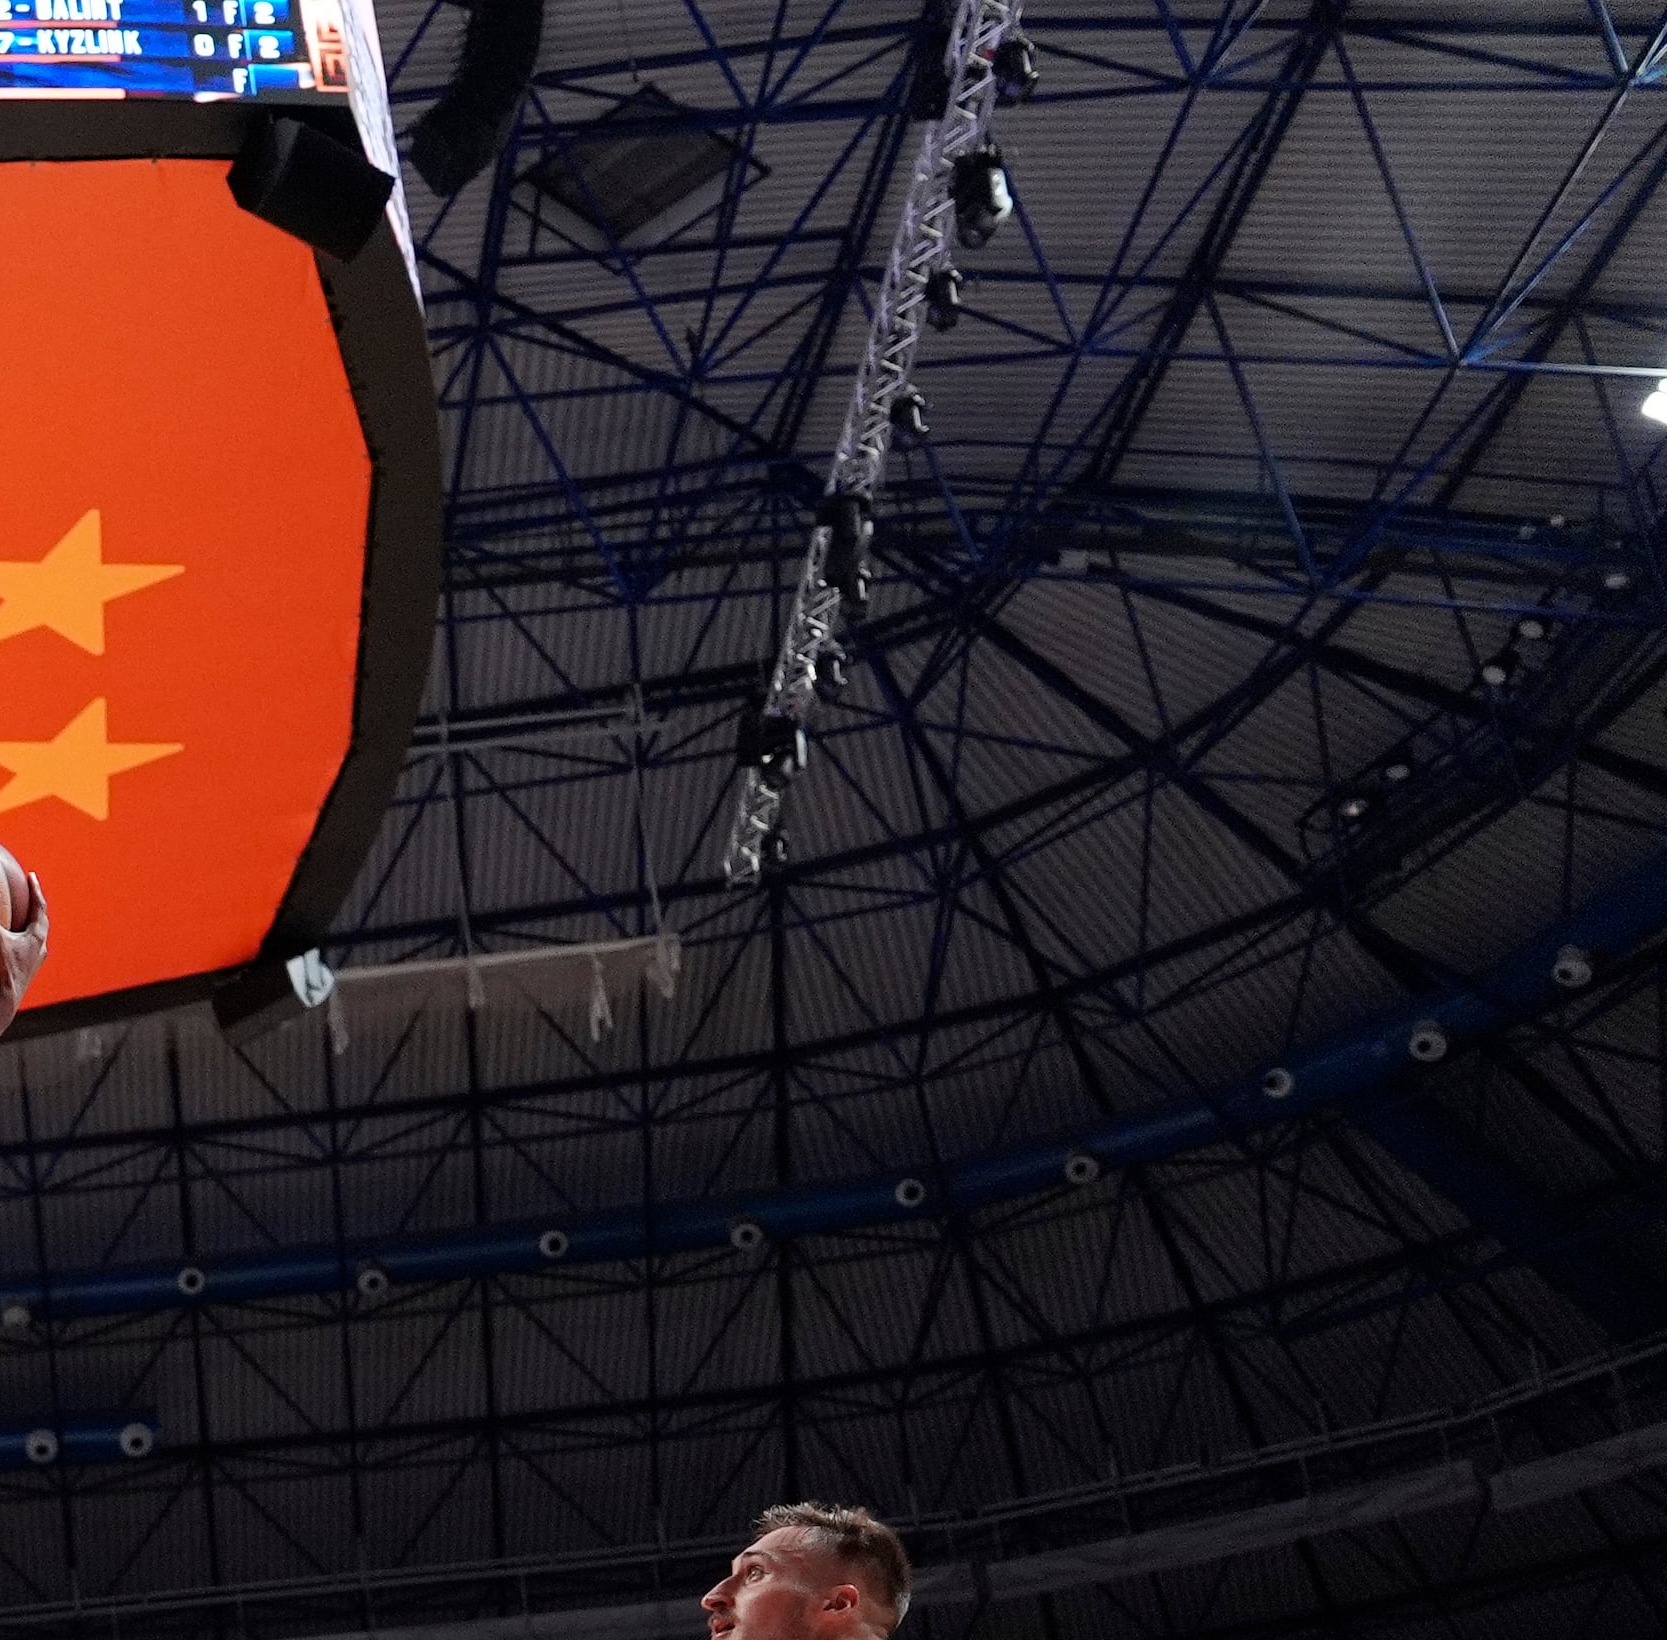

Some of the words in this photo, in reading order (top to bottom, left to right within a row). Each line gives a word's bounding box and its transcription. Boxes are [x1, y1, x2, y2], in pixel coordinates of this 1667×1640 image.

[223, 1, 239, 25] F
[37, 29, 142, 54] KYZLINK
[229, 34, 244, 58] F
